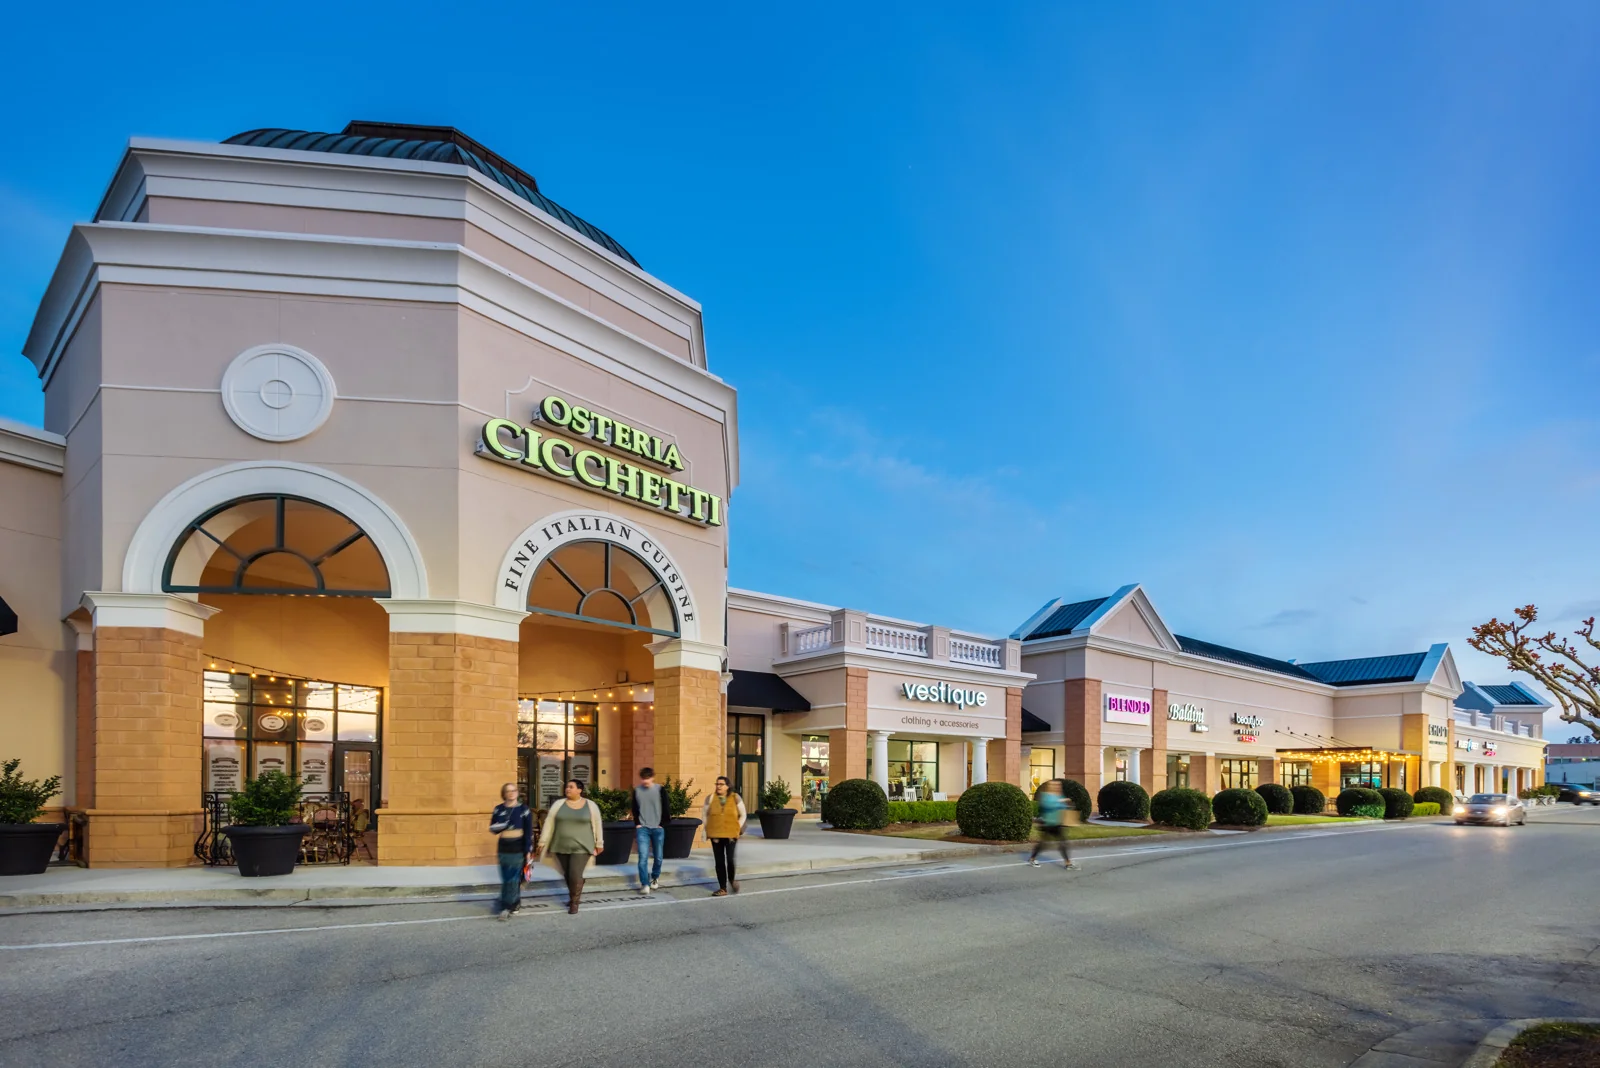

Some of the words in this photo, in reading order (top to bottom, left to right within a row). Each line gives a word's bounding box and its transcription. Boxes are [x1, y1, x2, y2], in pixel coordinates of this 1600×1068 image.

[540, 395, 685, 471] OSTERIA
[482, 418, 722, 527] CICCHETTI
[505, 540, 539, 592] FINE
[541, 517, 631, 541] ITALIAN
[641, 540, 694, 622] CUISINE
[902, 681, 988, 710] vestique
[1109, 697, 1150, 714] BLENDED
[901, 716, 931, 727] clothing
[940, 720, 979, 729] accessories
[1168, 703, 1205, 723] Baldini
